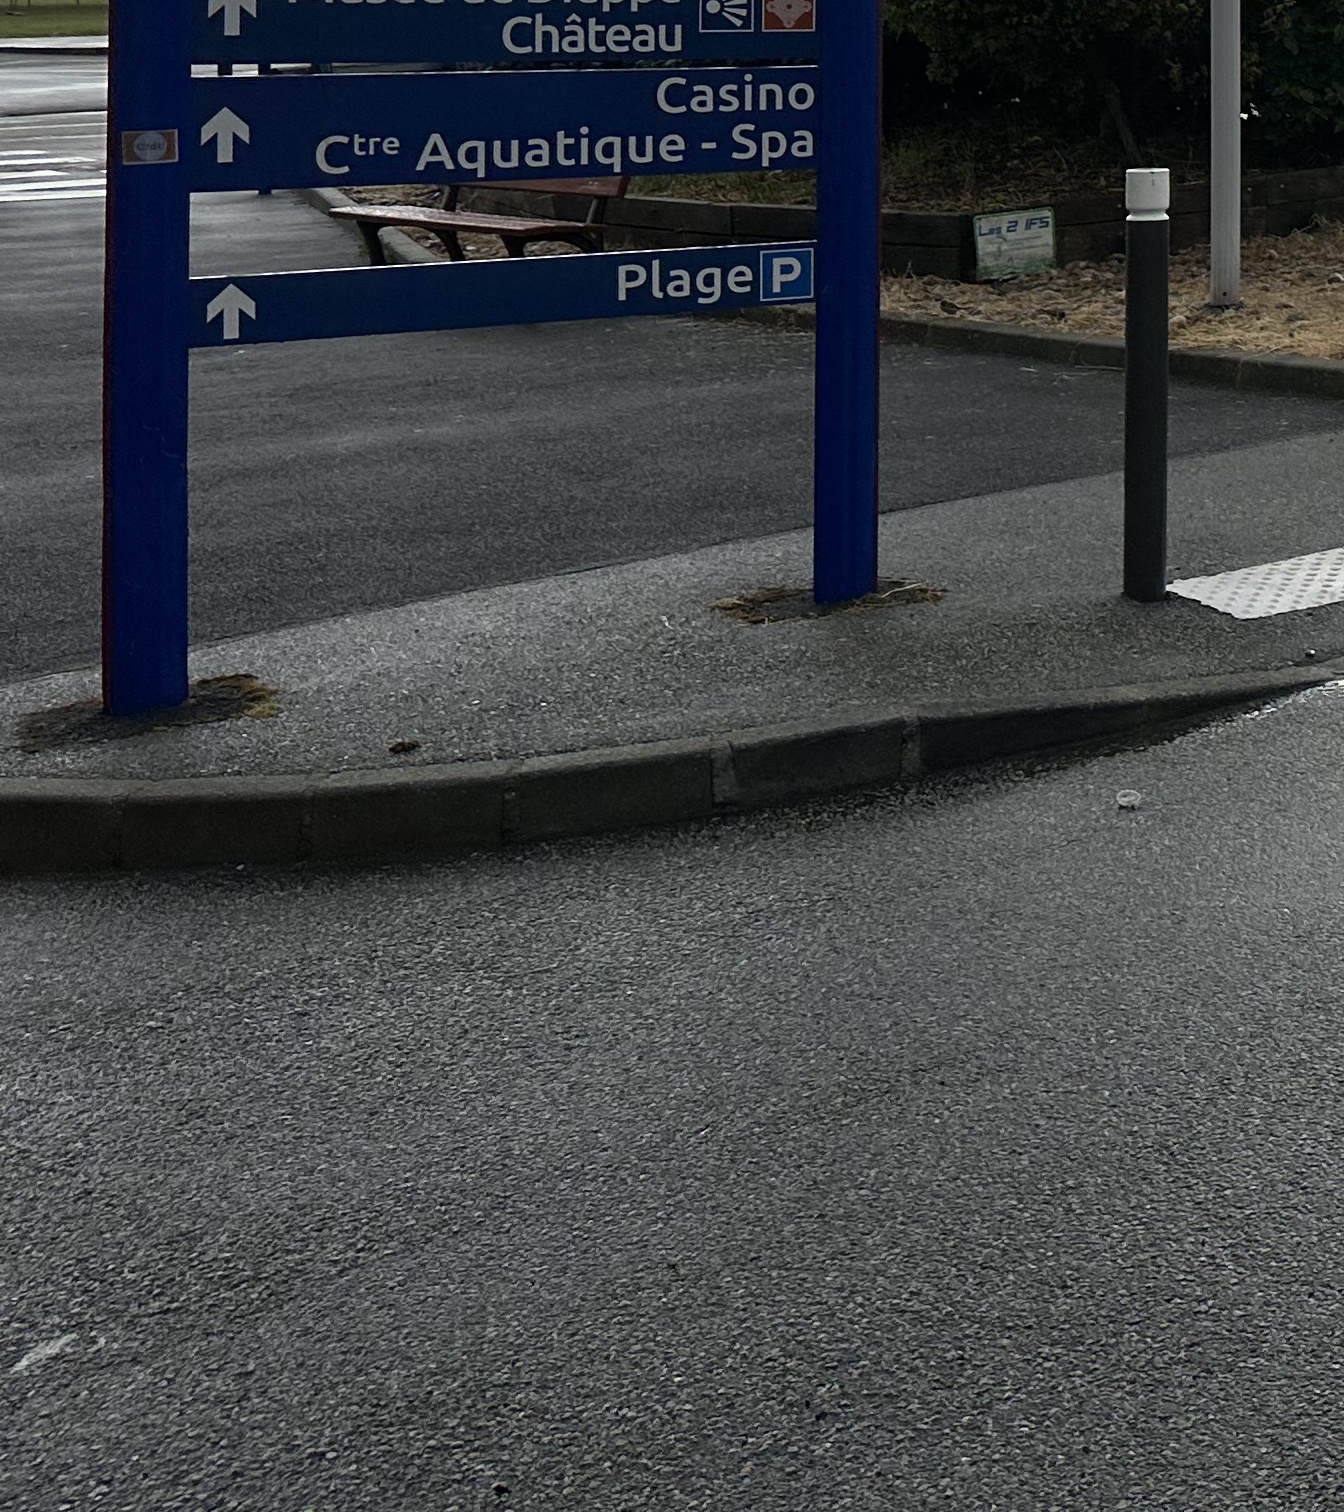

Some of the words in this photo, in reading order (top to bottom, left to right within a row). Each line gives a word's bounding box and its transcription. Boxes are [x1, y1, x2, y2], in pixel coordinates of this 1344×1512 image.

[502, 13, 683, 55] Château
[657, 74, 816, 114] Casino
[315, 133, 401, 175] Ctre
[415, 126, 687, 178] Aquatique
[731, 124, 815, 168] Spa
[1006, 219, 1019, 234] 2
[617, 258, 754, 304] Plage
